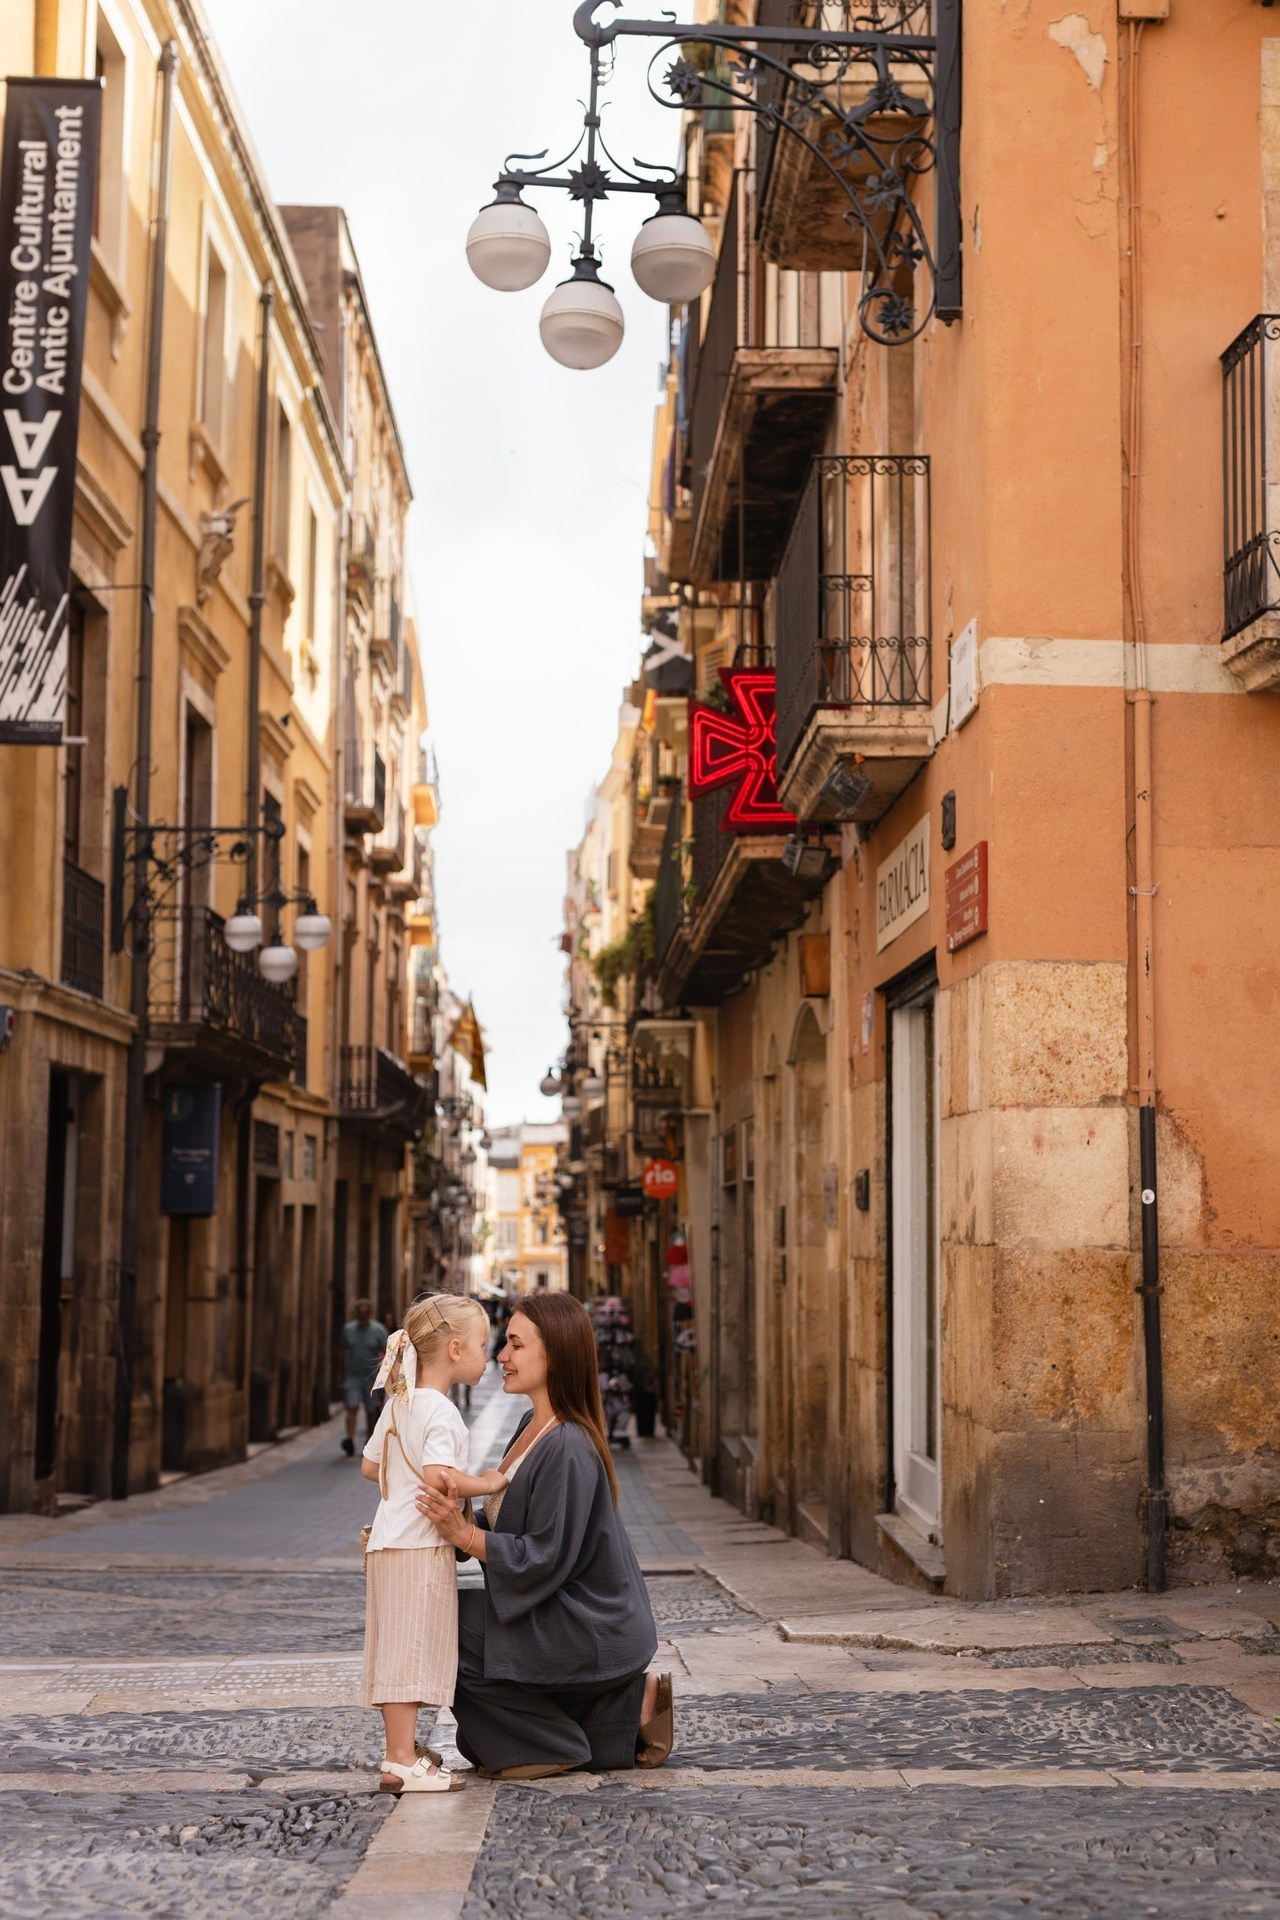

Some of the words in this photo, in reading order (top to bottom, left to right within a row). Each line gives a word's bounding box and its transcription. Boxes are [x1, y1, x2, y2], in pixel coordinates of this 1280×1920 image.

[10, 140, 48, 272] Cultural
[42, 105, 83, 299] Ajuntament
[2, 280, 39, 395] Centre
[36, 306, 70, 396] Antic
[645, 1163, 676, 1185] ria
